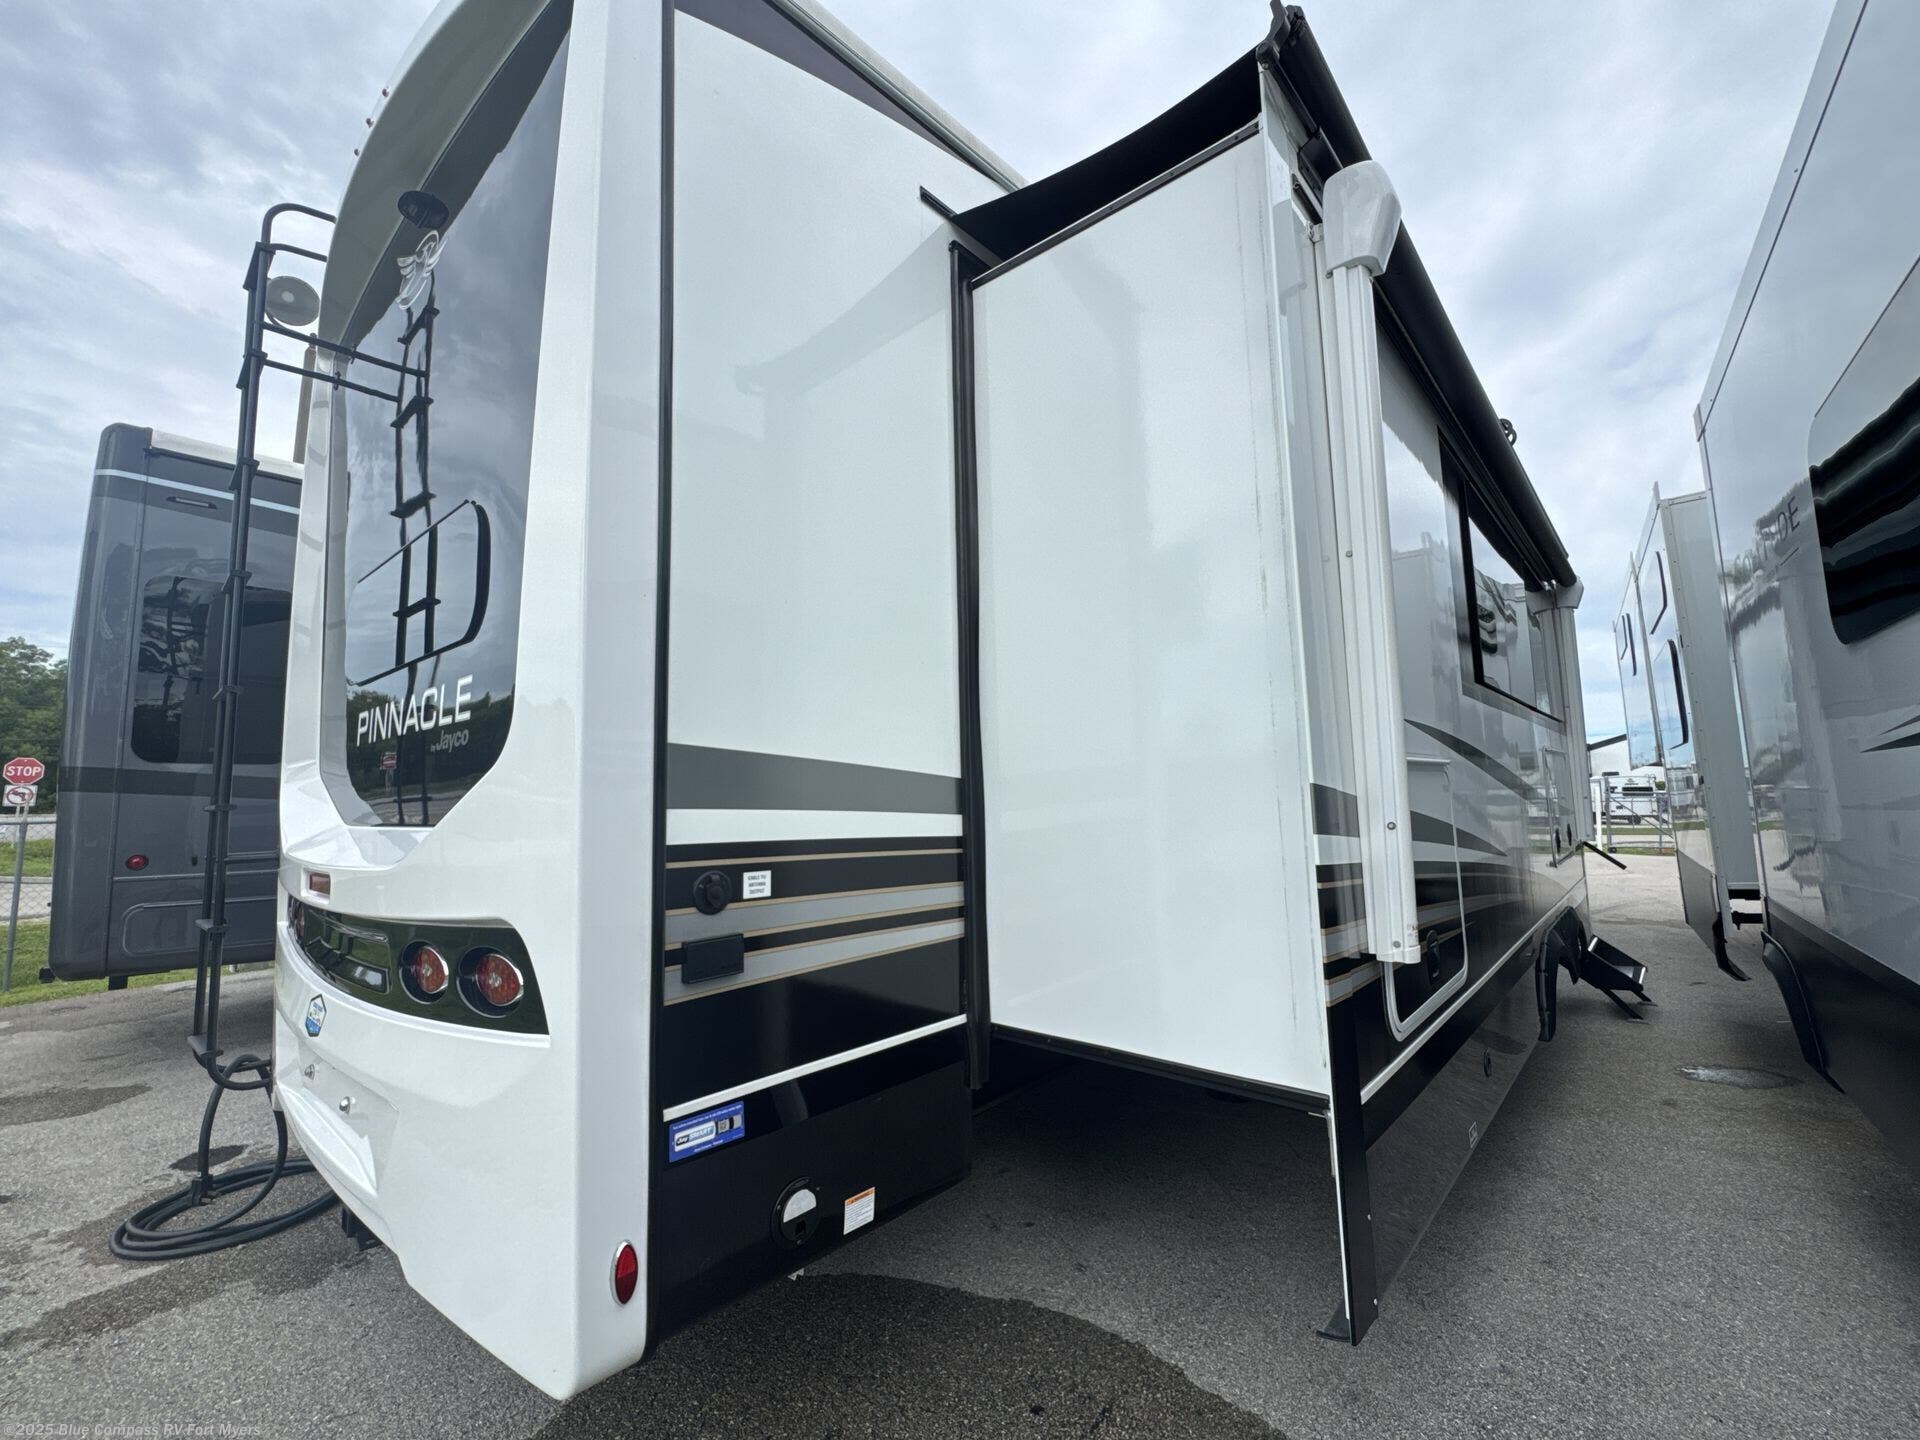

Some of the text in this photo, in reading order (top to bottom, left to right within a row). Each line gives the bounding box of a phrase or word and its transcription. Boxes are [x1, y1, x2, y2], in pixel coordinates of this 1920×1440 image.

[356, 674, 473, 747] PINNACLE
[436, 729, 469, 753] Jayco
[6, 765, 42, 777] STOP
